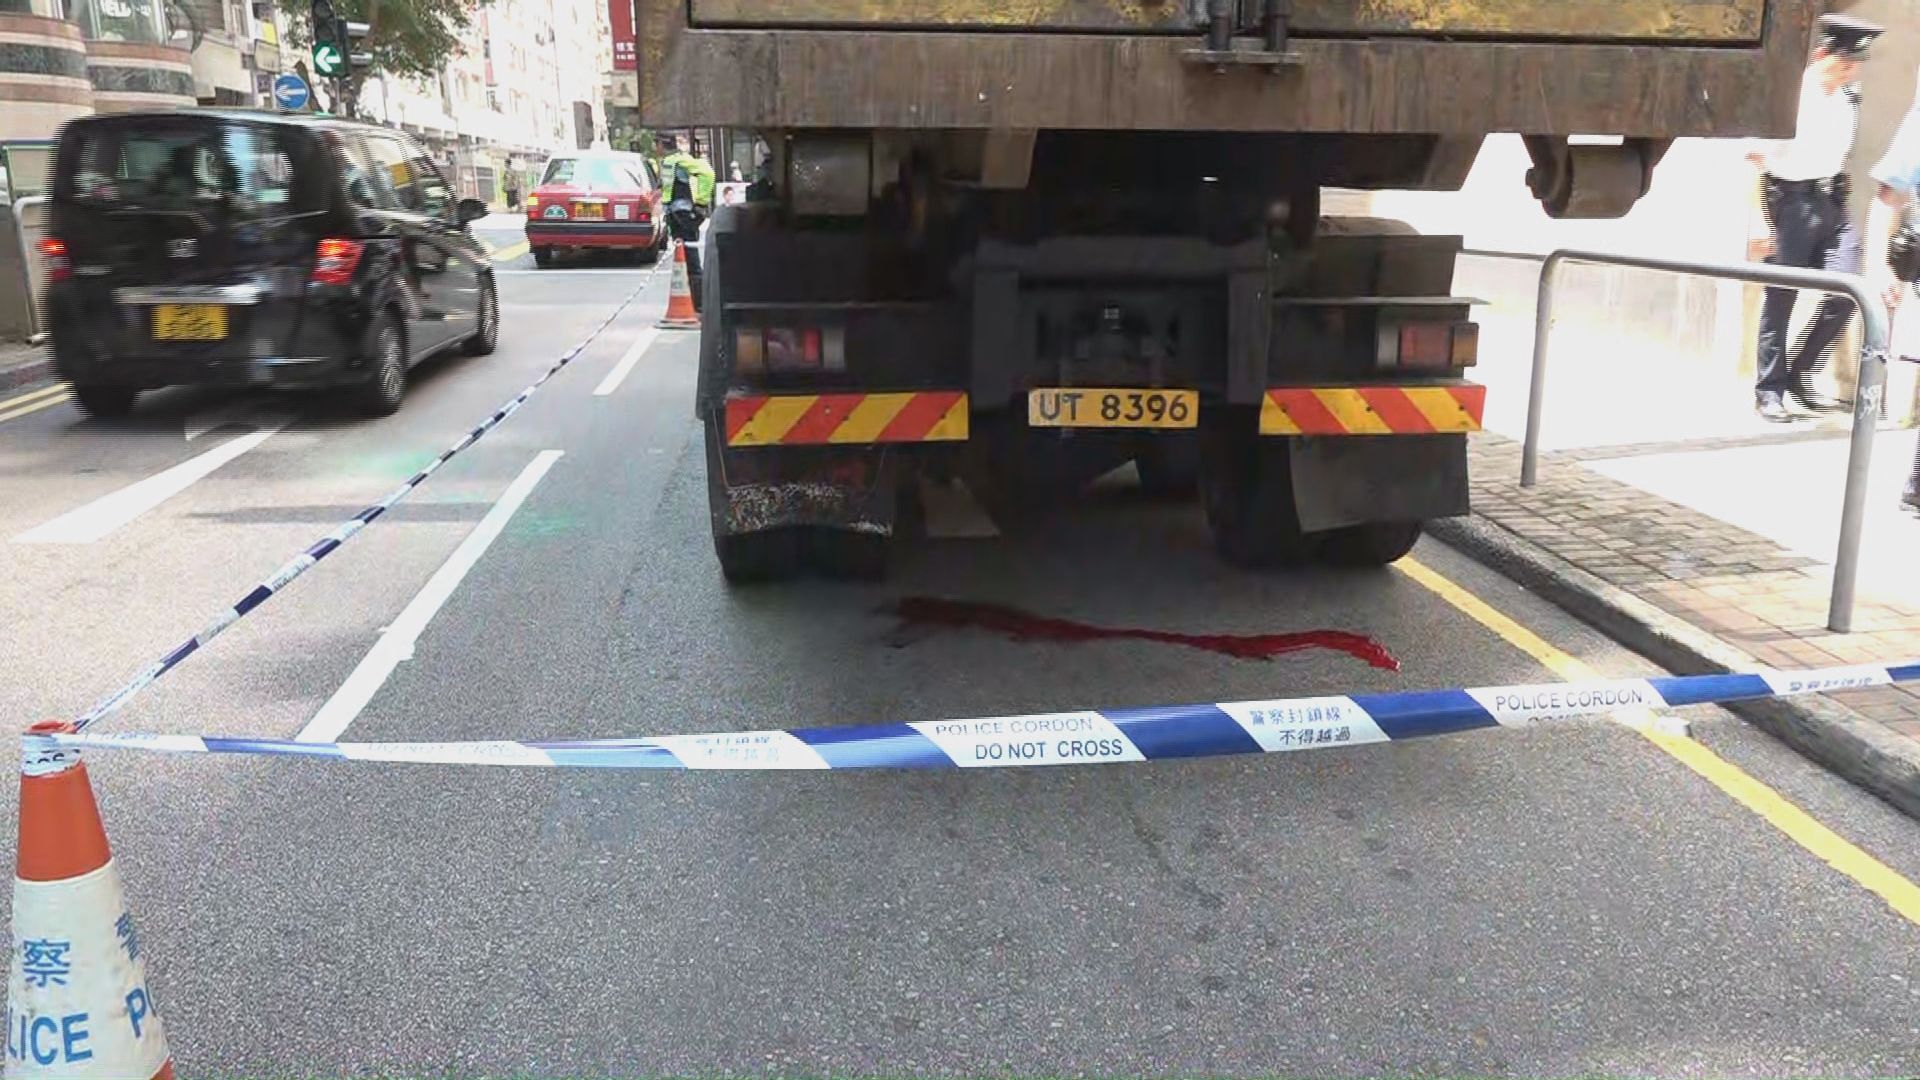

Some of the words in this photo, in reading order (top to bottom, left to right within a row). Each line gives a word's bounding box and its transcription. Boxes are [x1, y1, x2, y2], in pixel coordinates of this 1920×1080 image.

[1039, 393, 1084, 421] UT
[1101, 393, 1188, 422] 8396
[1496, 694, 1561, 711] POLICE
[936, 722, 1003, 737] POLICE
[1278, 726, 1351, 745] 不得越過
[975, 743, 1003, 760] DO
[1008, 742, 1046, 760] NOT
[1057, 739, 1124, 757] CROSS
[22, 938, 70, 988] 察
